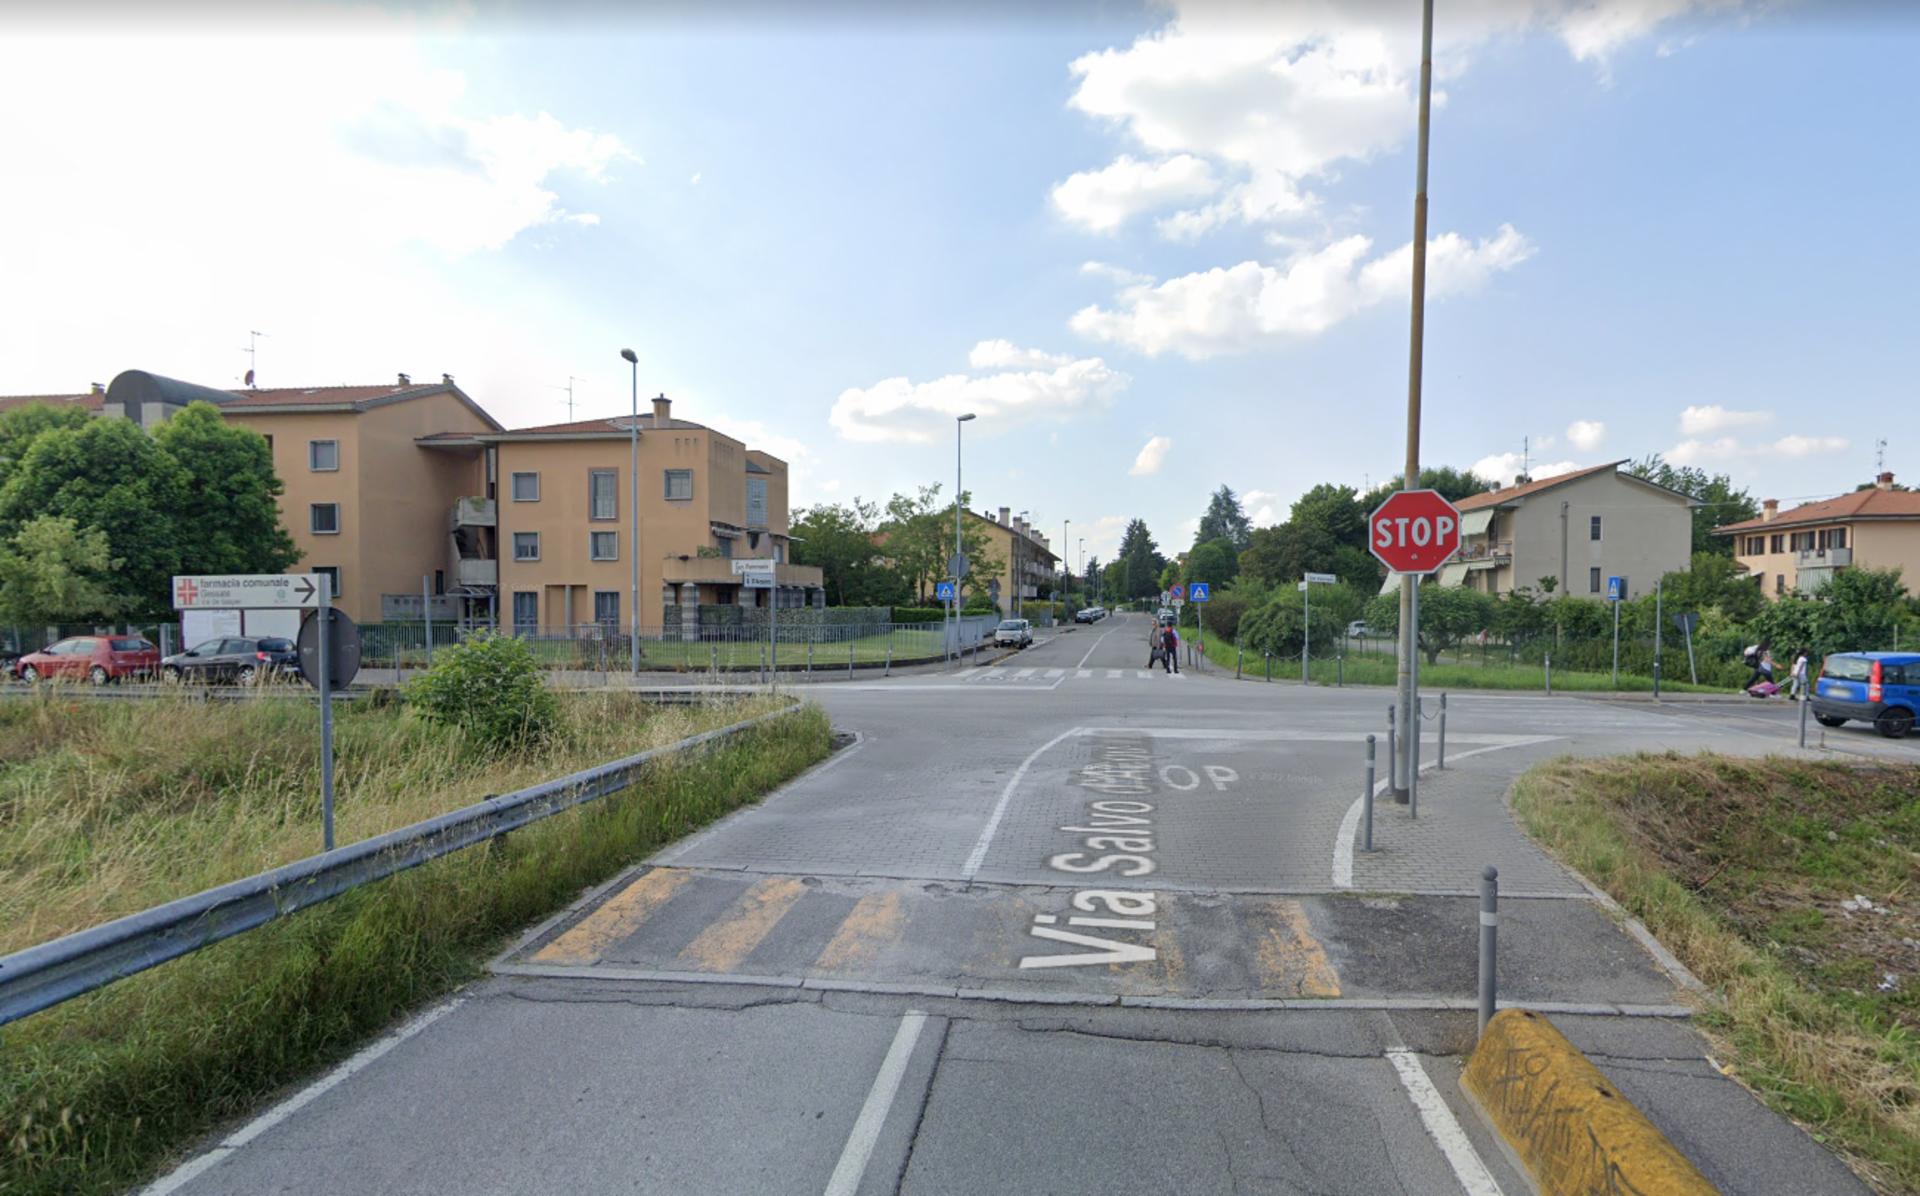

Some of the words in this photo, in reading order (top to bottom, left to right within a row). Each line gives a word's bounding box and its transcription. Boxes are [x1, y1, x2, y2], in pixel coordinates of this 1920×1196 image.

[1375, 516, 1454, 548] STOP
[200, 578, 240, 588] farmacia
[243, 577, 289, 587] comunale
